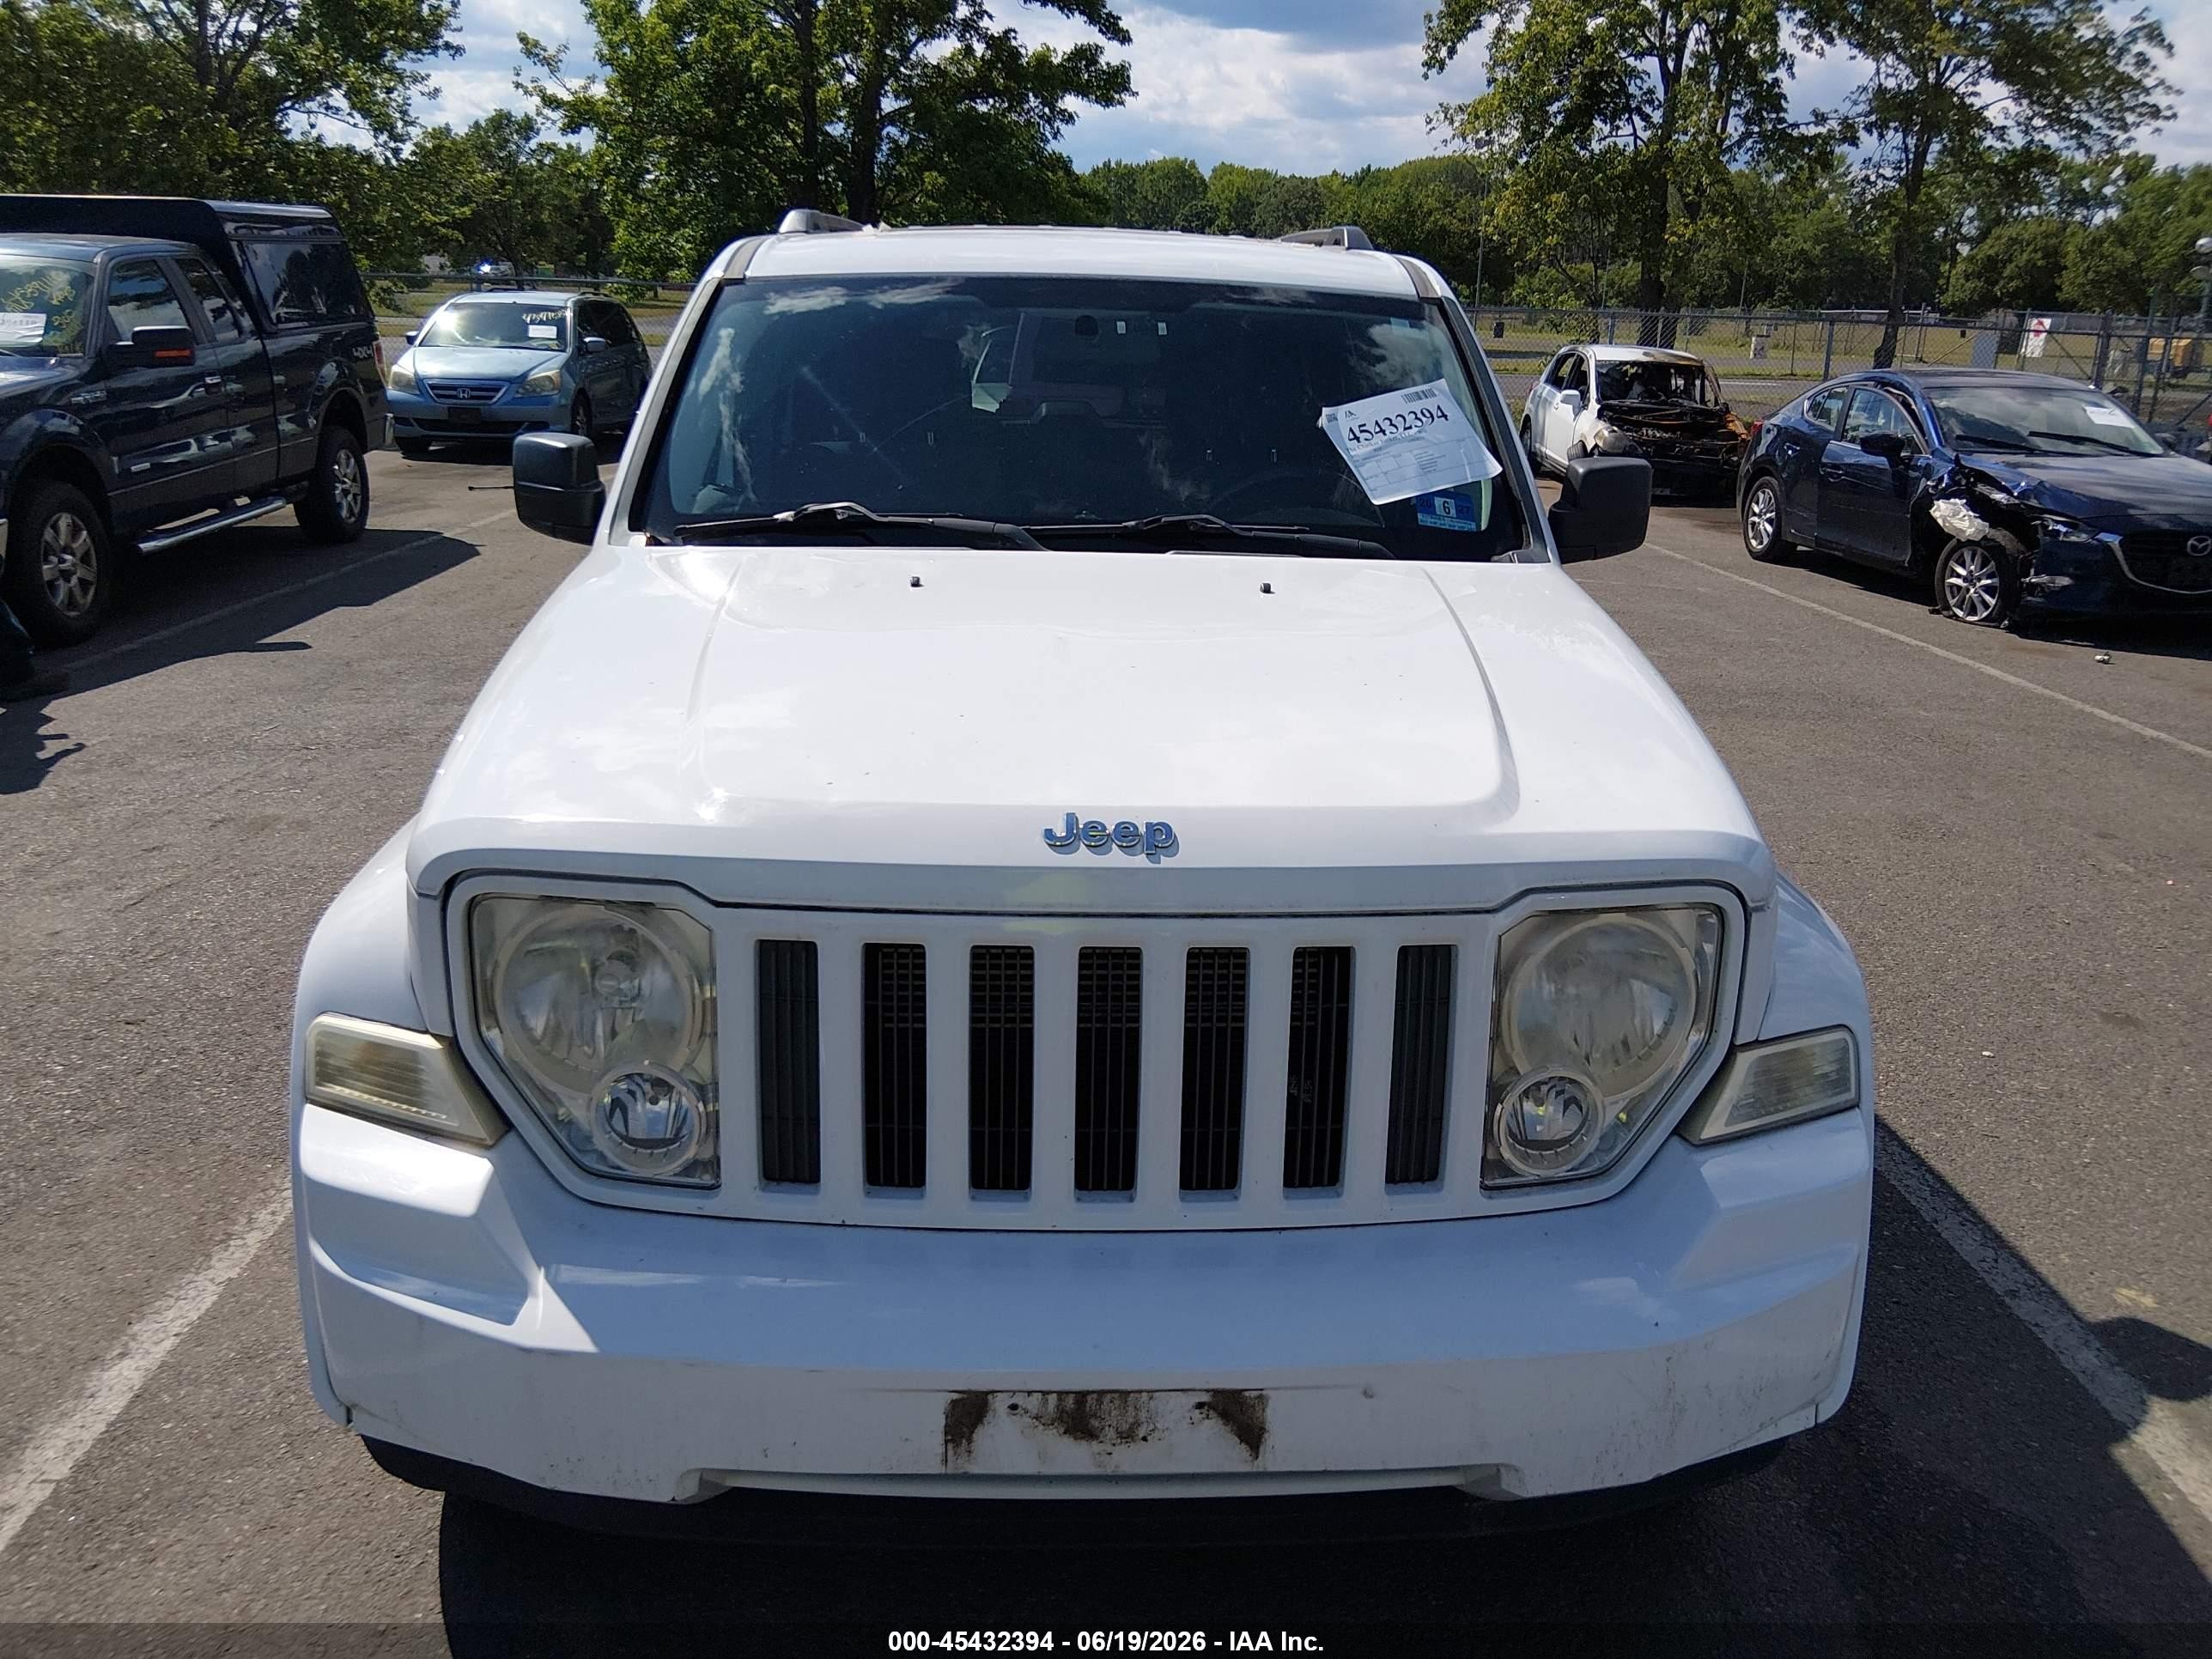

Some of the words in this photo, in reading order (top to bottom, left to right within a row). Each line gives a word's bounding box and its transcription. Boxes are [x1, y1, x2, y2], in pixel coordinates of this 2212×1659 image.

[1347, 404, 1449, 444] 45432394
[1443, 500, 1451, 515] 6
[1044, 811, 1175, 854] Jeep
